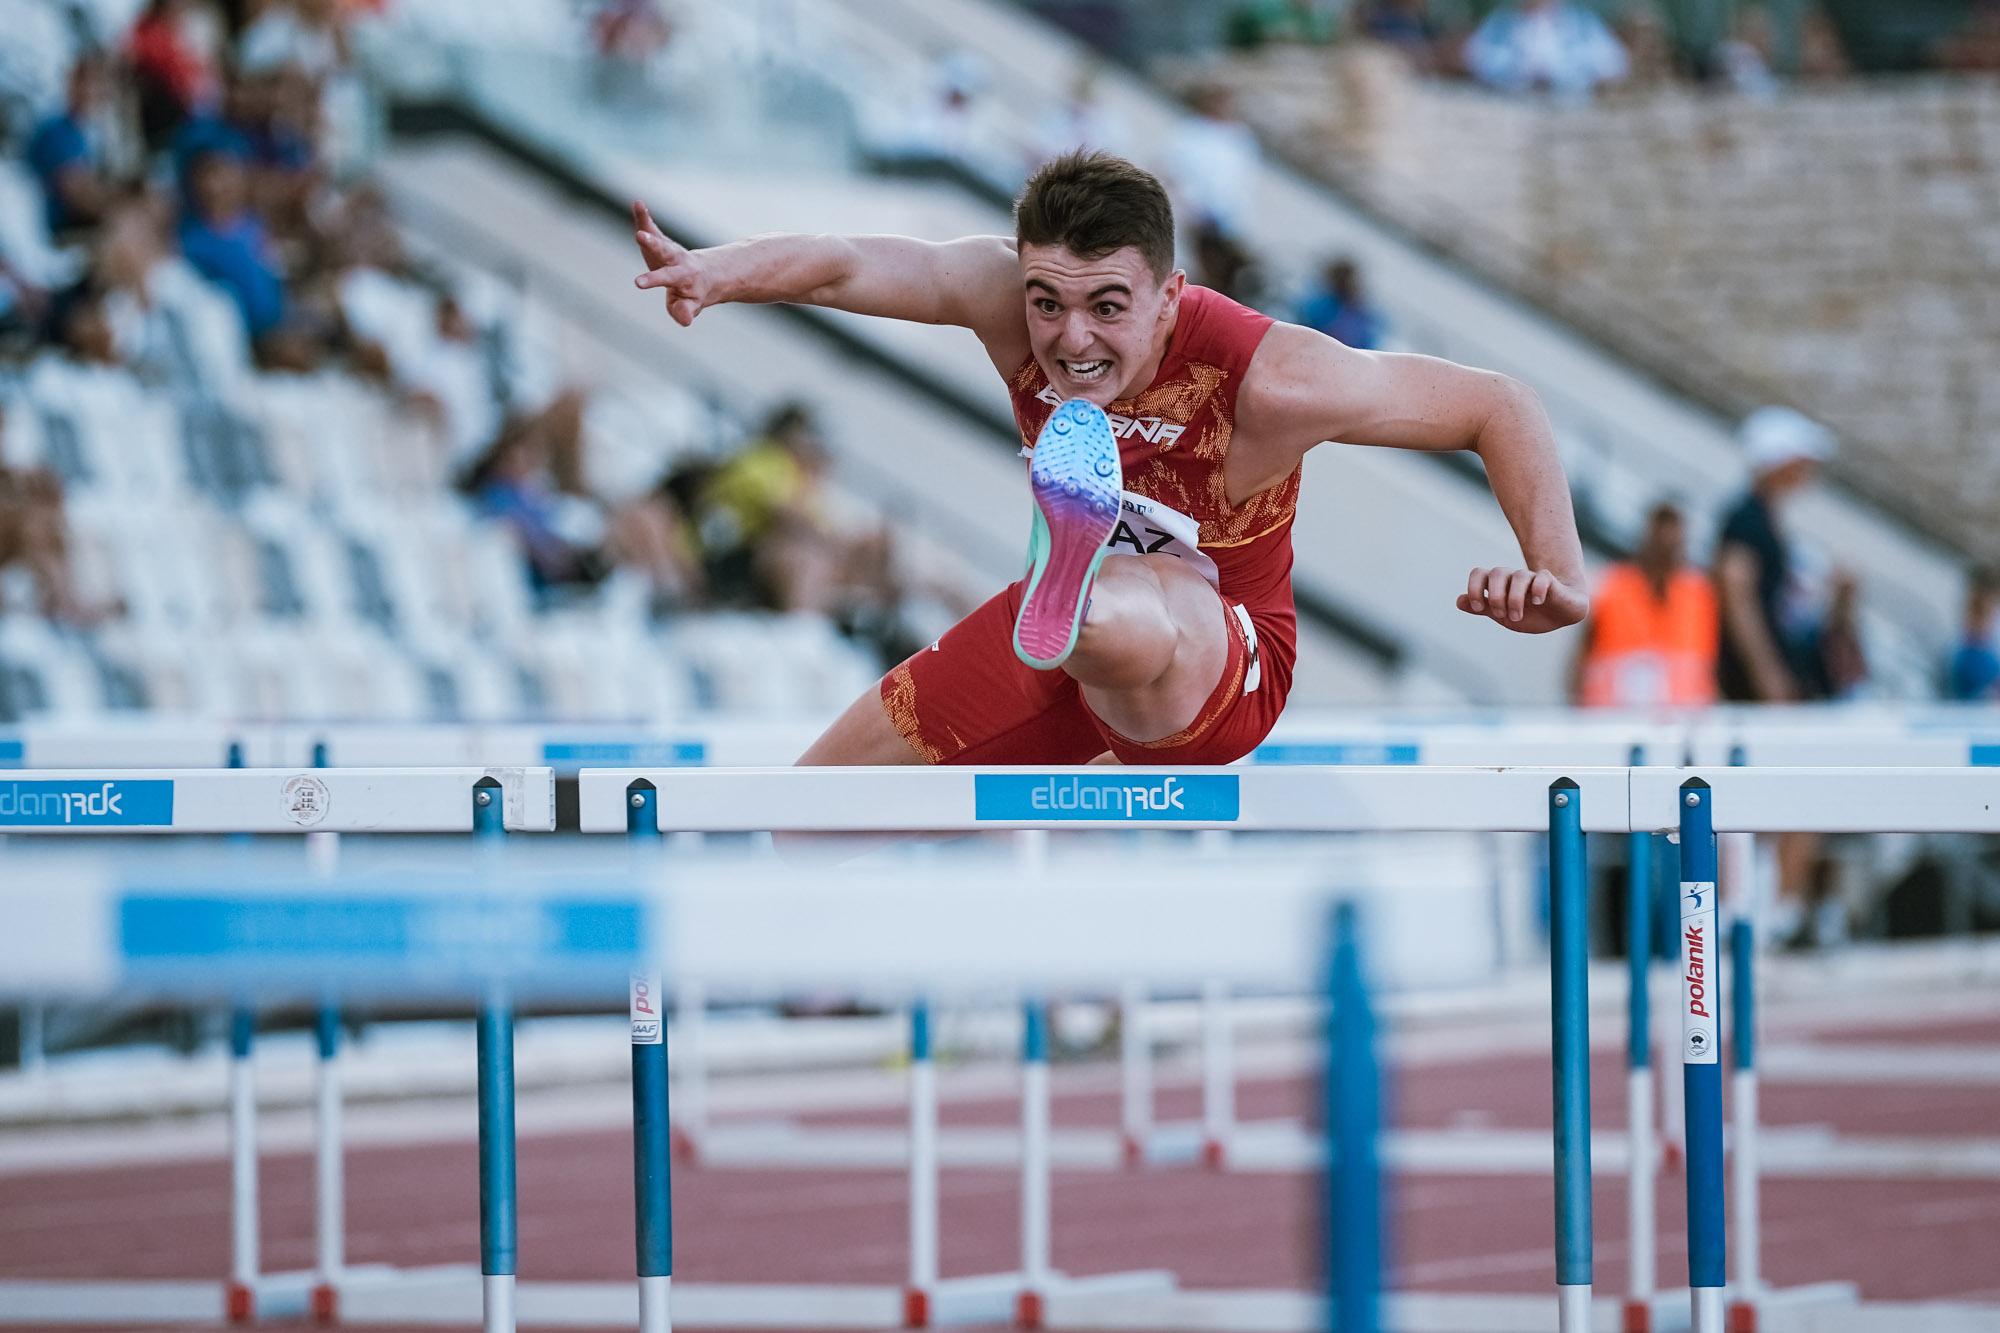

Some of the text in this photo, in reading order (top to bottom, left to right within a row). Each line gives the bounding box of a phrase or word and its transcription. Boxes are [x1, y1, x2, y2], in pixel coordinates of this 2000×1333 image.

[1107, 520, 1181, 558] AZ
[0, 783, 62, 816] dan
[1684, 924, 1710, 1018] polanik
